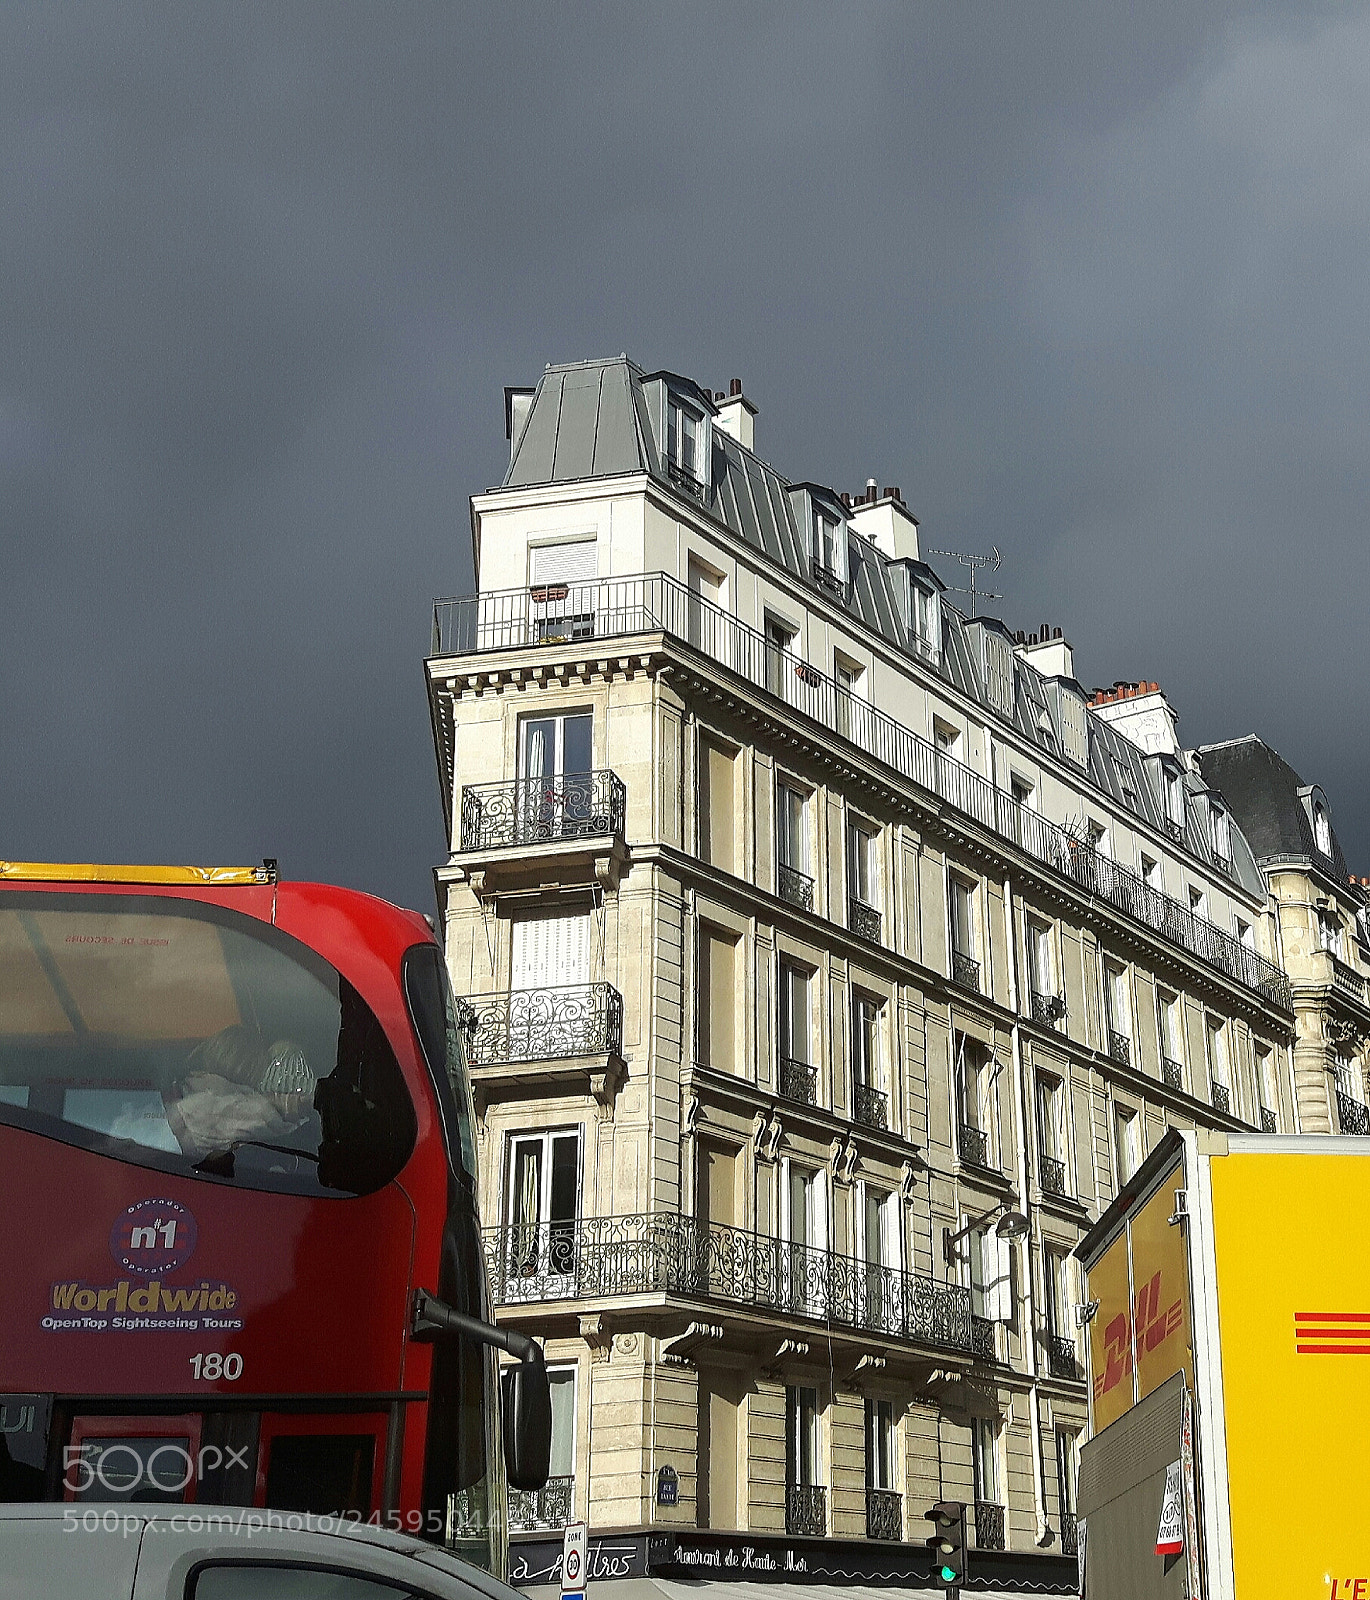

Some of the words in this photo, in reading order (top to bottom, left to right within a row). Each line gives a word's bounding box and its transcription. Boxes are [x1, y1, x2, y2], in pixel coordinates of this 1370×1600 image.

[127, 1199, 184, 1214] Operador
[122, 1257, 177, 1274] Operator
[53, 1281, 236, 1313] Worldwide
[41, 1317, 108, 1329] OpenTop
[112, 1317, 198, 1330] Sightseeing
[202, 1317, 242, 1328] Tours
[1102, 1270, 1168, 1395] DHL
[189, 1353, 244, 1381] 180
[567, 1531, 582, 1543] ZONE
[569, 1559, 577, 1571] 30
[1331, 1578, 1370, 1600] L'E
